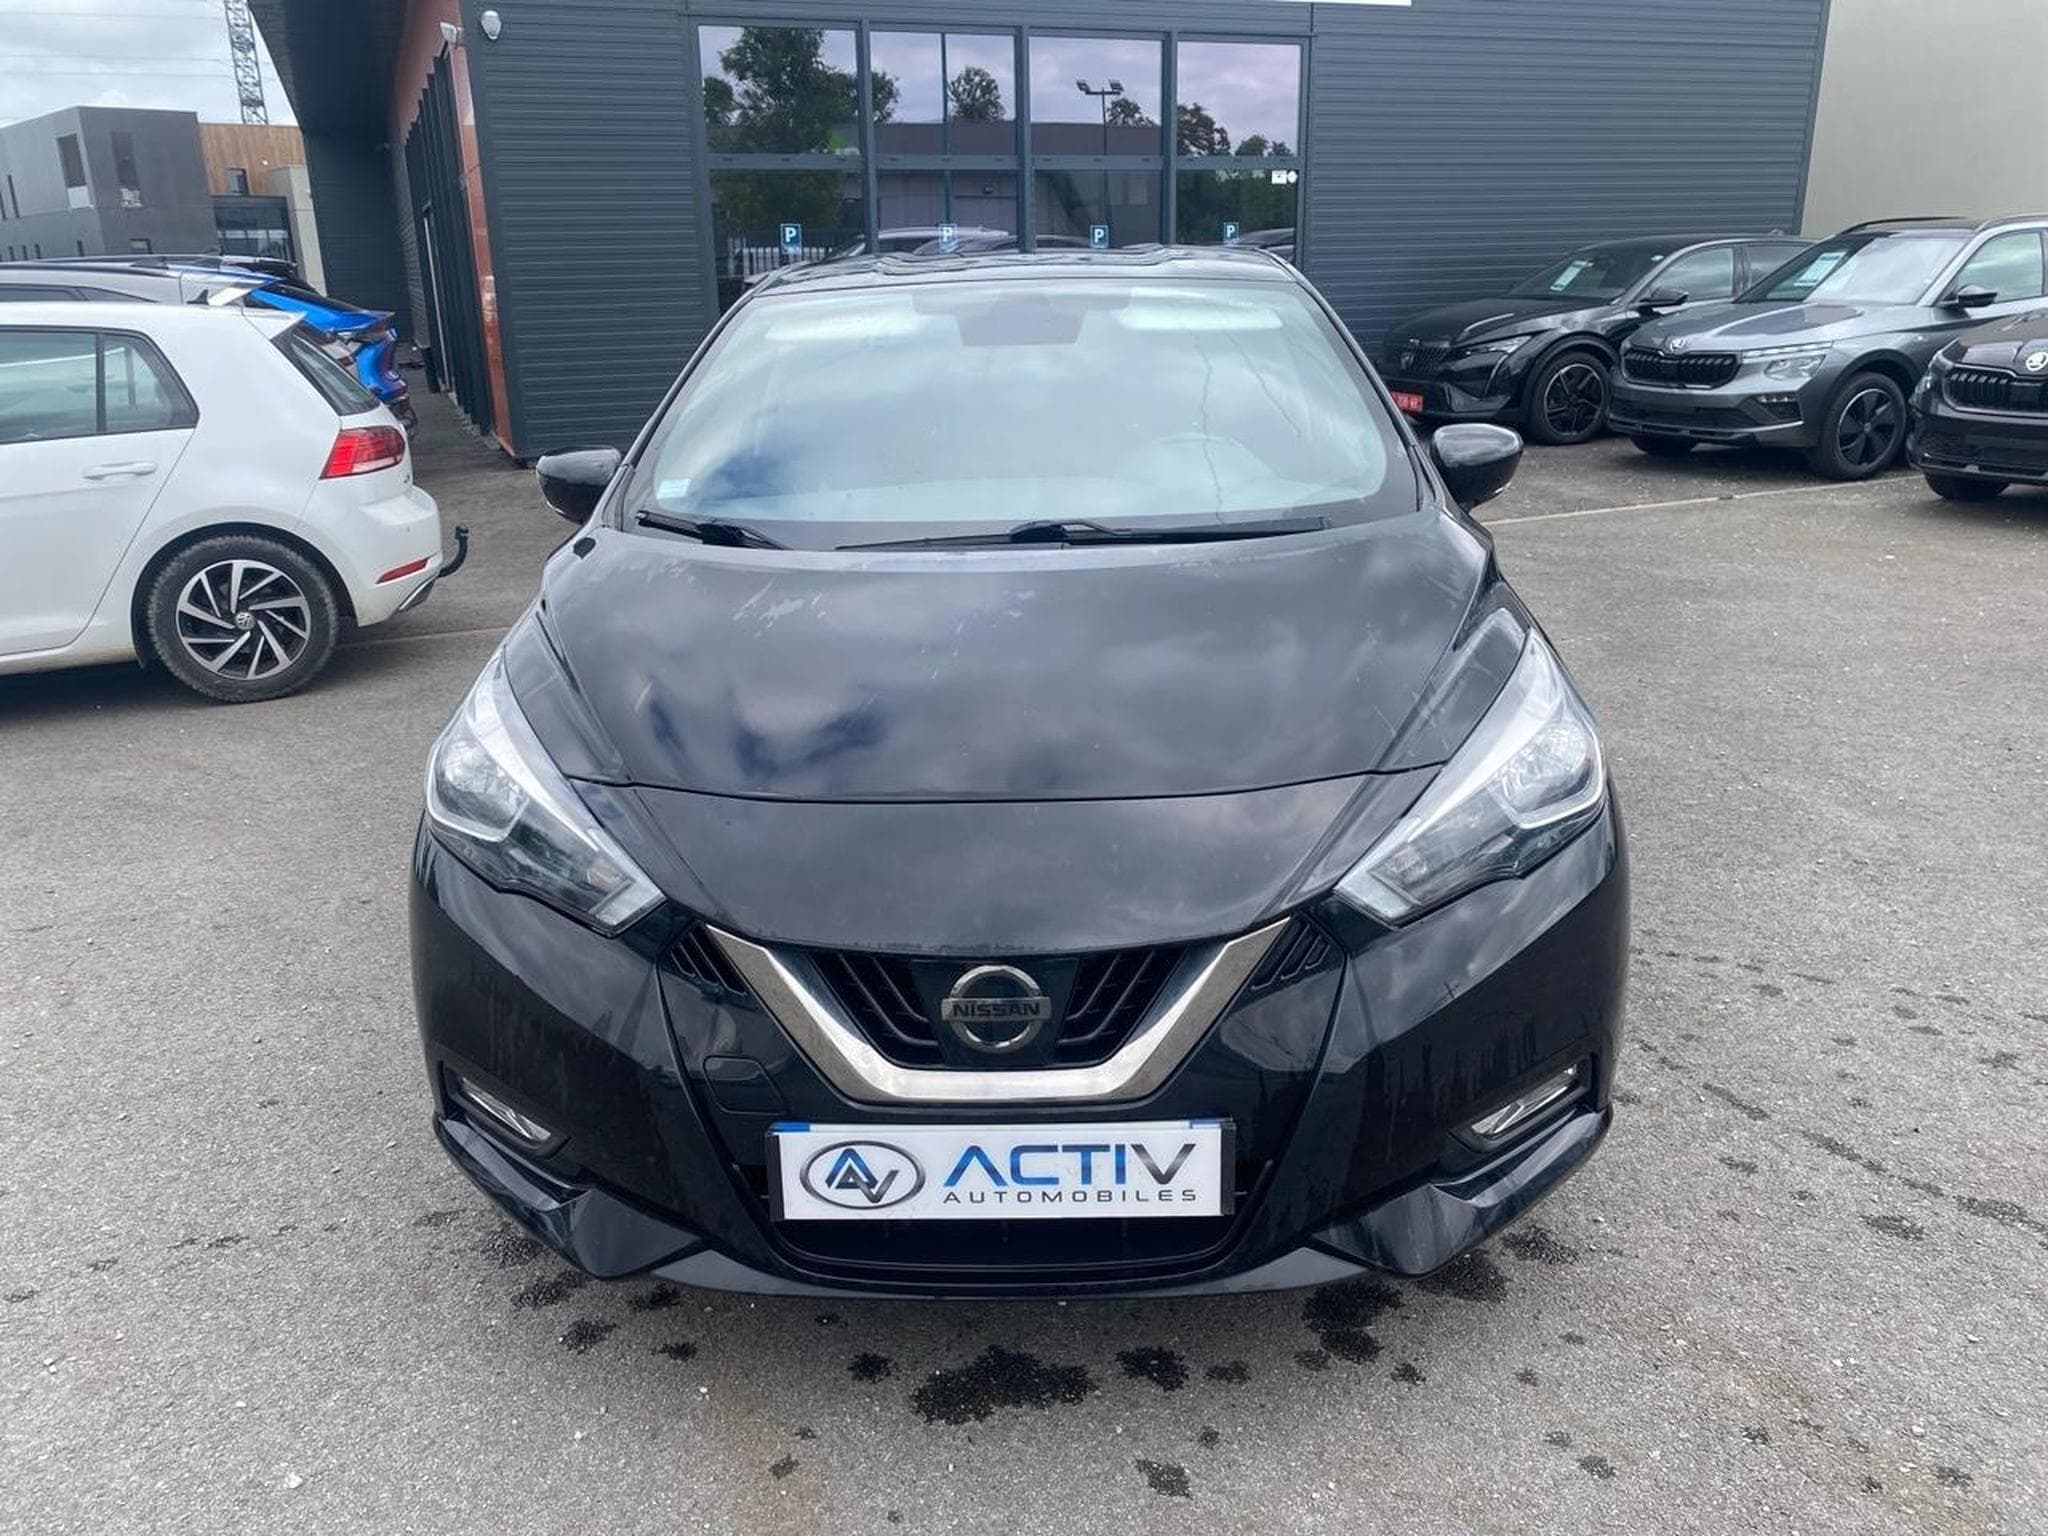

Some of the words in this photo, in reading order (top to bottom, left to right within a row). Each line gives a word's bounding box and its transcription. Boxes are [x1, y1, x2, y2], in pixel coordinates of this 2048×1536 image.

[784, 226, 797, 243] P
[942, 226, 954, 242] P
[1094, 228, 1105, 243] P
[1226, 224, 1237, 238] P
[952, 1002, 1040, 1017] NISSAN
[943, 1143, 1197, 1187] ACTIV
[943, 1189, 1197, 1204] AUTOMOBILES
